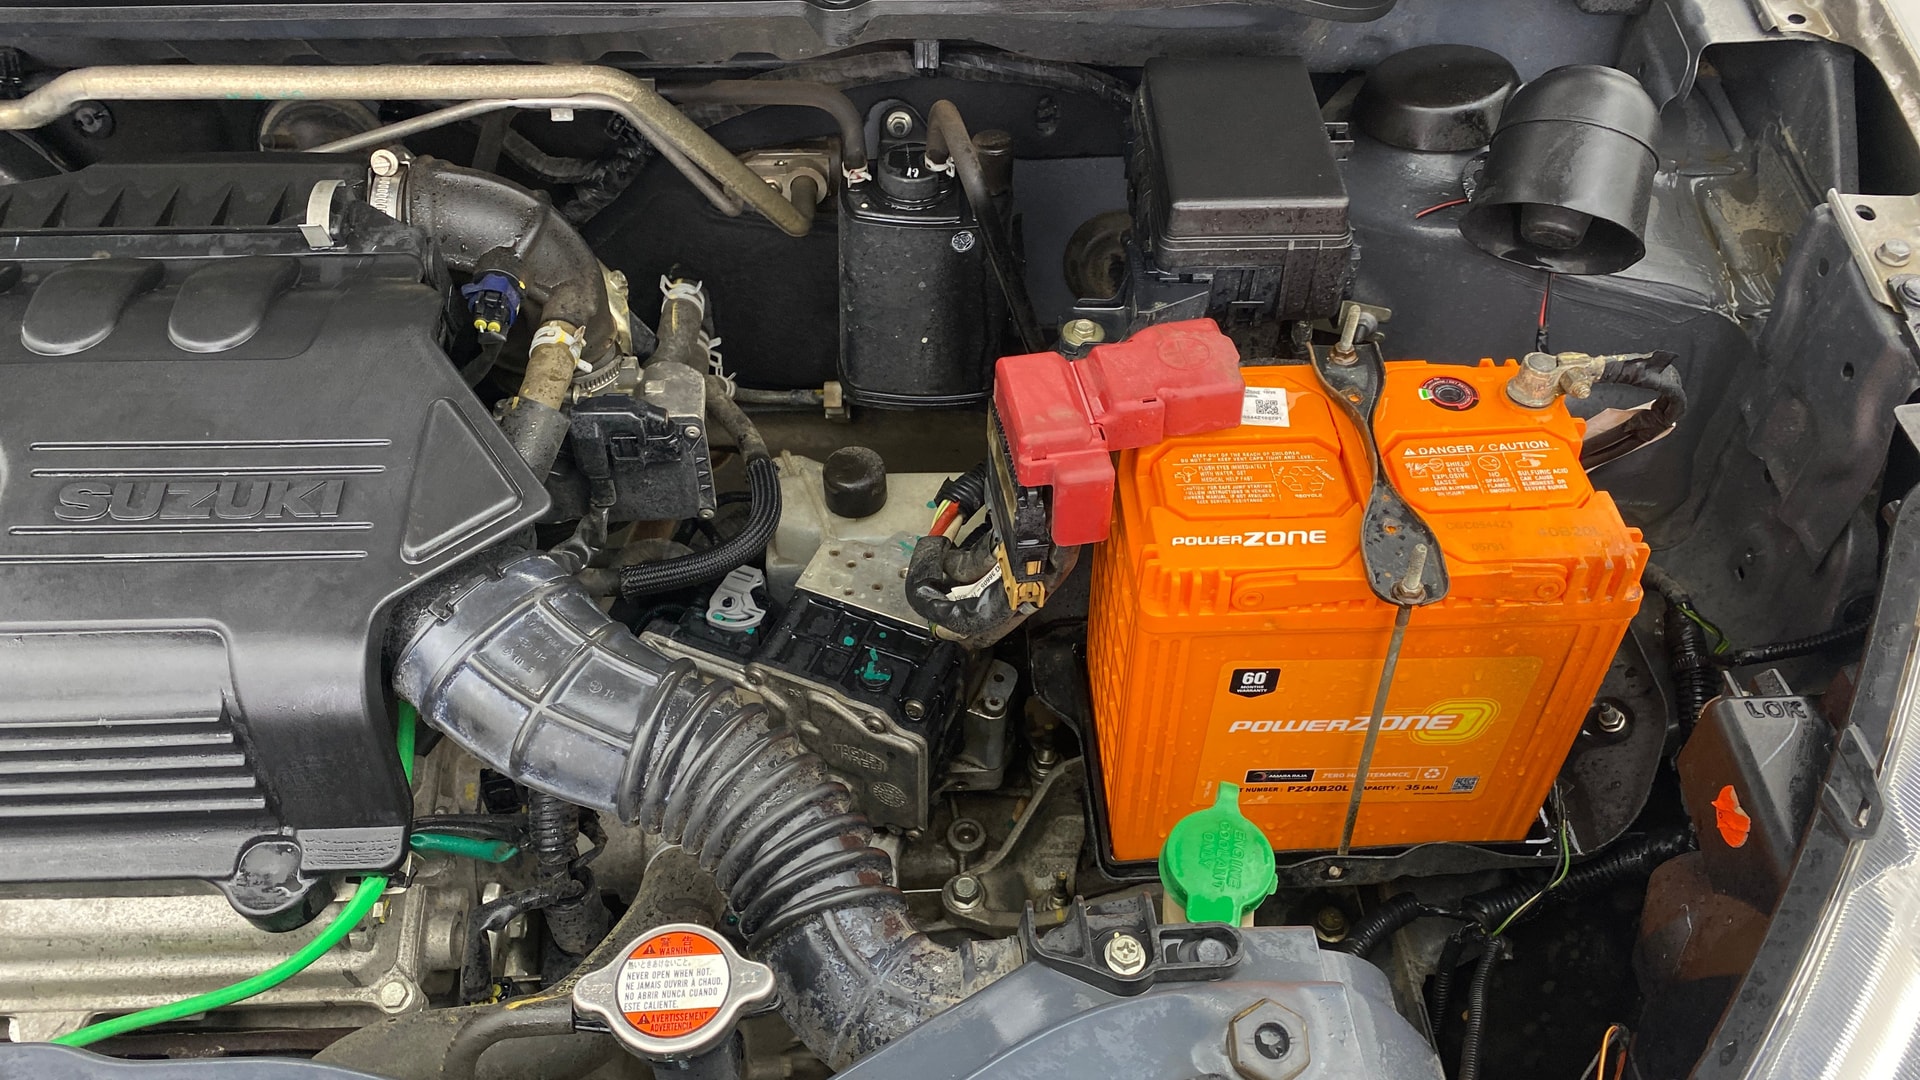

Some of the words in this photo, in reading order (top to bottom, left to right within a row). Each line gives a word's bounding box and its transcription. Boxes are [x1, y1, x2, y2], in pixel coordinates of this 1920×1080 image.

[1418, 444, 1475, 456] DANGER
[1478, 444, 1485, 452] /
[1488, 440, 1550, 452] CAUTION
[53, 478, 347, 522] SUZUKI
[1744, 700, 1808, 719] LOK
[1228, 714, 1457, 733] POWERZONE
[1287, 784, 1349, 793] PZ40B20L
[1198, 832, 1215, 869] ONLY
[1212, 821, 1231, 892] COOLANT
[1227, 830, 1246, 888] ENGINE
[659, 946, 693, 956] WARNING
[626, 971, 650, 980] NEVER
[652, 970, 670, 979] OPEN
[674, 969, 694, 978] WHEN
[696, 968, 712, 977] HOT.
[740, 971, 758, 984] 1.1
[625, 981, 634, 991] NE
[636, 980, 662, 990] JAMAIS
[664, 979, 689, 989] OUVRIR
[698, 976, 724, 986] CHAUD.
[624, 992, 634, 1001] NO
[638, 991, 659, 1000] ABRIR
[662, 989, 686, 999] NUNCA
[688, 987, 718, 997] CUANDO
[624, 1002, 640, 1011] ESTE
[643, 1000, 680, 1010] CALIENTE.
[651, 1011, 708, 1023] AVERTISSEMENT
[650, 1021, 693, 1032] ADVERTENCIA
